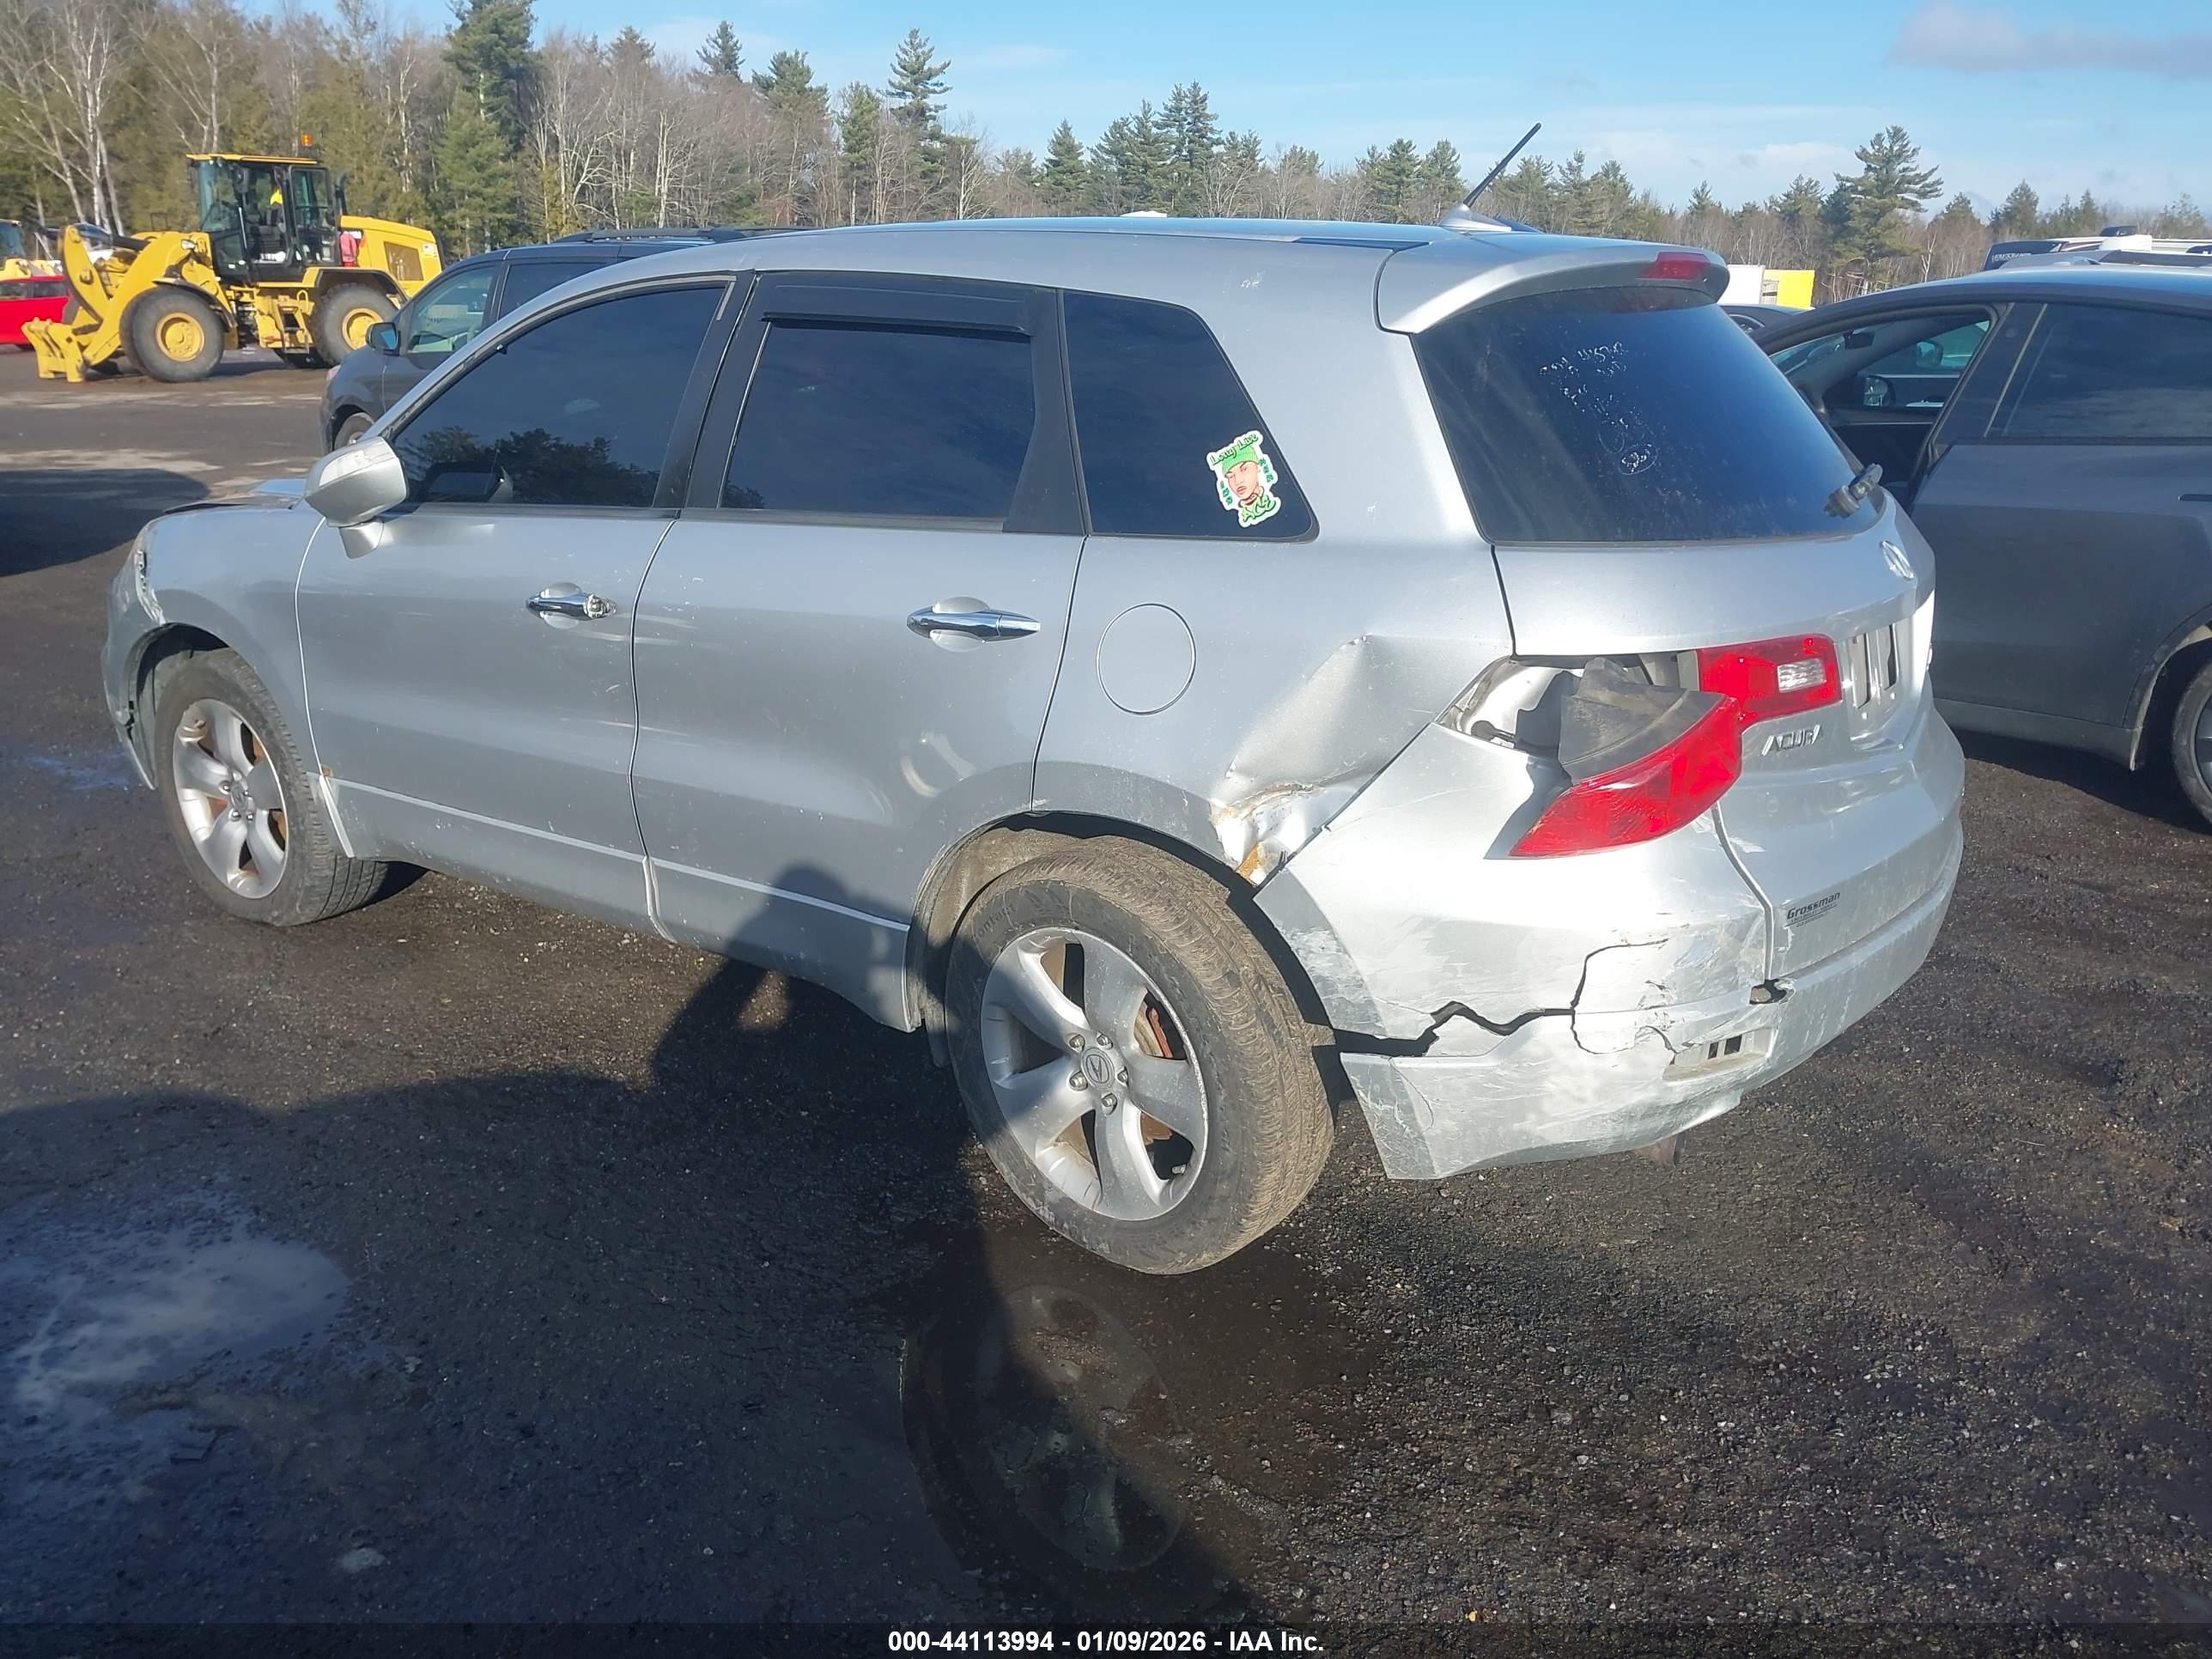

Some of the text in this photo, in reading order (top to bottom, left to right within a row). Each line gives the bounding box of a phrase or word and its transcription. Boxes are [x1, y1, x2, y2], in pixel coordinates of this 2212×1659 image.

[1210, 433, 1259, 465] Long Live
[1761, 724, 1820, 756] ACURA
[1787, 892, 1840, 920] Grossman
